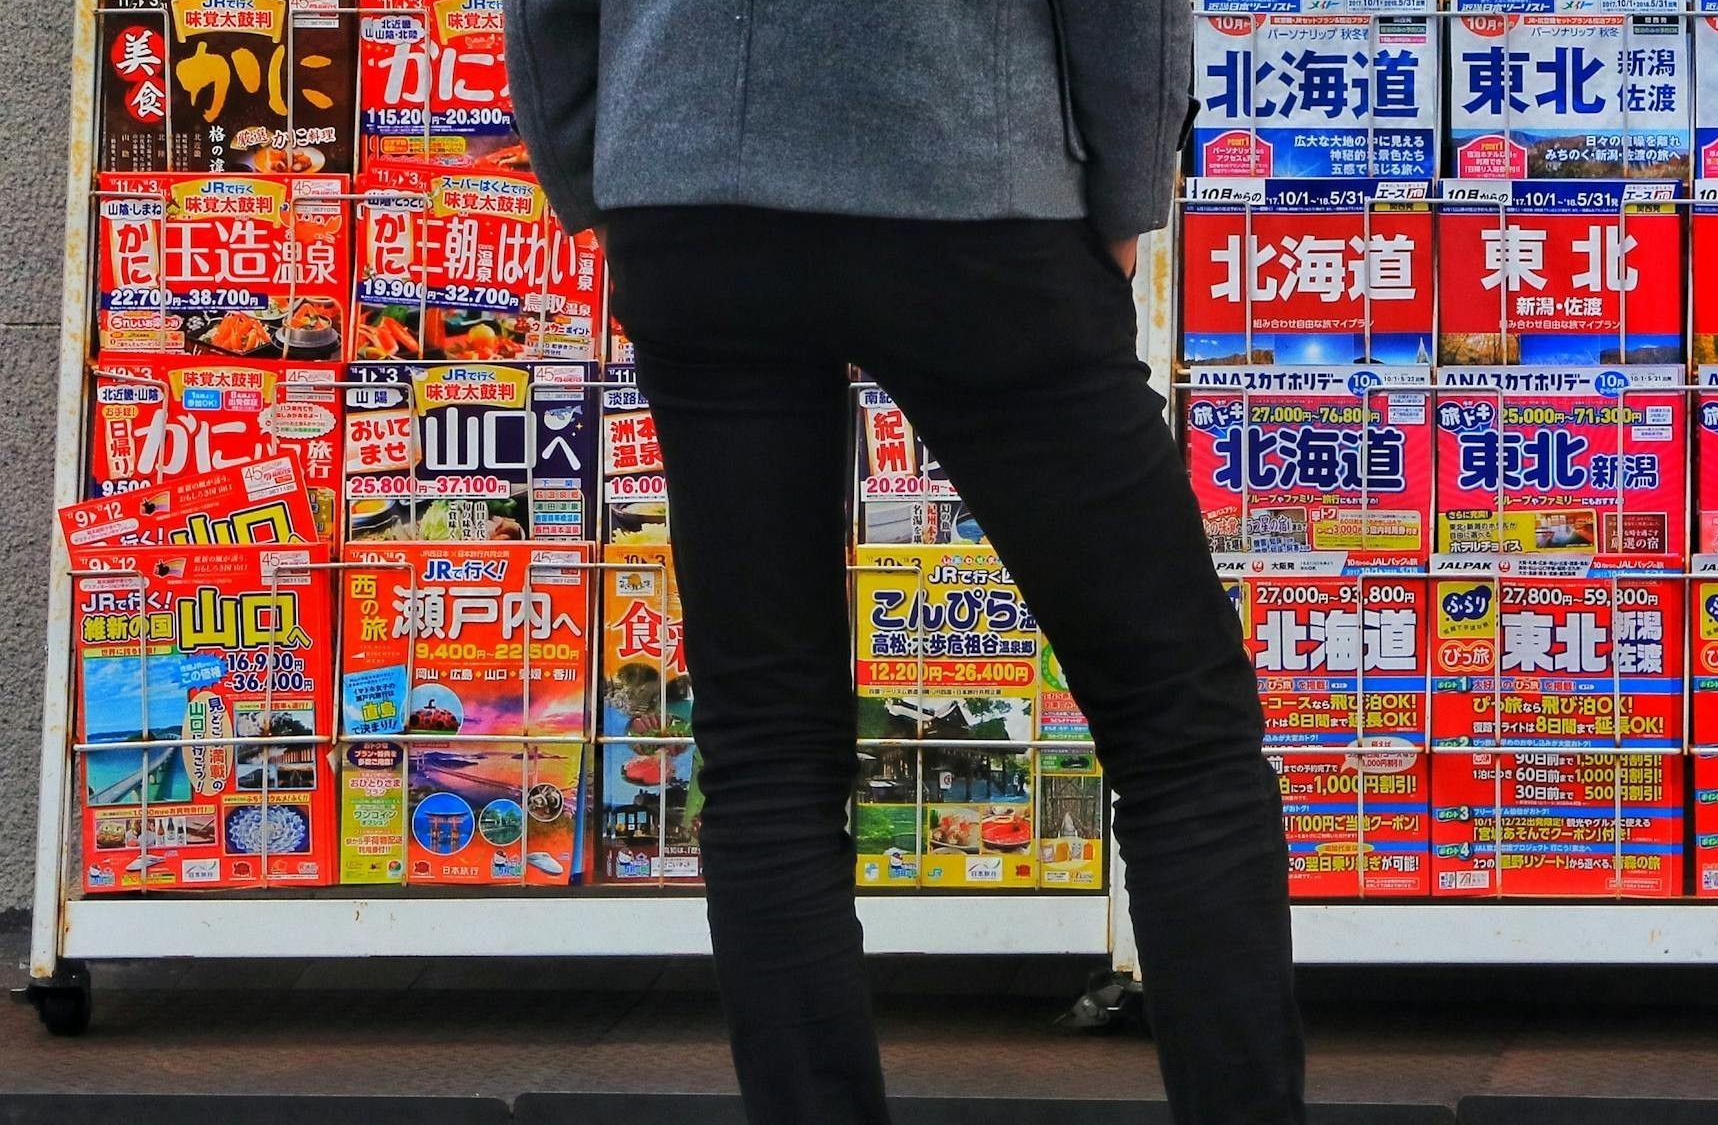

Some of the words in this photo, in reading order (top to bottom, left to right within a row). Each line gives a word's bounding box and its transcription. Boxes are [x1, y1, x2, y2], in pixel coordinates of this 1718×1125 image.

[185, 9, 273, 29] 味覚太鼓判
[1268, 27, 1338, 39] パーソナリップ
[1597, 26, 1619, 38] 秋冬
[1206, 49, 1419, 118] 北海道
[1461, 46, 1606, 115] 東北
[201, 183, 254, 195] JRで行く
[1378, 185, 1406, 199] エース
[184, 196, 273, 214] 味覚太鼓判
[444, 195, 532, 214] 味覚太鼓判
[1210, 233, 1416, 302] 北海道
[1480, 224, 1638, 292] 東北
[577, 258, 594, 292] 温泉
[1516, 296, 1602, 317] 新潟・佐渡
[183, 371, 262, 389] 味覚太鼓判
[1198, 372, 1345, 394] ANAスカイホリデー
[1444, 372, 1590, 394] ANAスカイホリデー
[356, 390, 387, 403] 山陽
[426, 382, 514, 401] 味覚太鼓判
[109, 421, 132, 478] 日帰り
[874, 410, 906, 472] 紀州
[1215, 428, 1405, 491] 北海道
[1459, 430, 1587, 491] 東北
[423, 561, 505, 582] JRで行く!
[1271, 561, 1295, 571] 大阪発
[1437, 560, 1492, 571] JALPAK
[81, 592, 173, 612] JRで行く!
[351, 574, 387, 642] 西の旅
[227, 653, 303, 672] 16,900円
[1442, 647, 1491, 667] ぴっ旅
[870, 663, 1028, 681] 12,200円~26,400円
